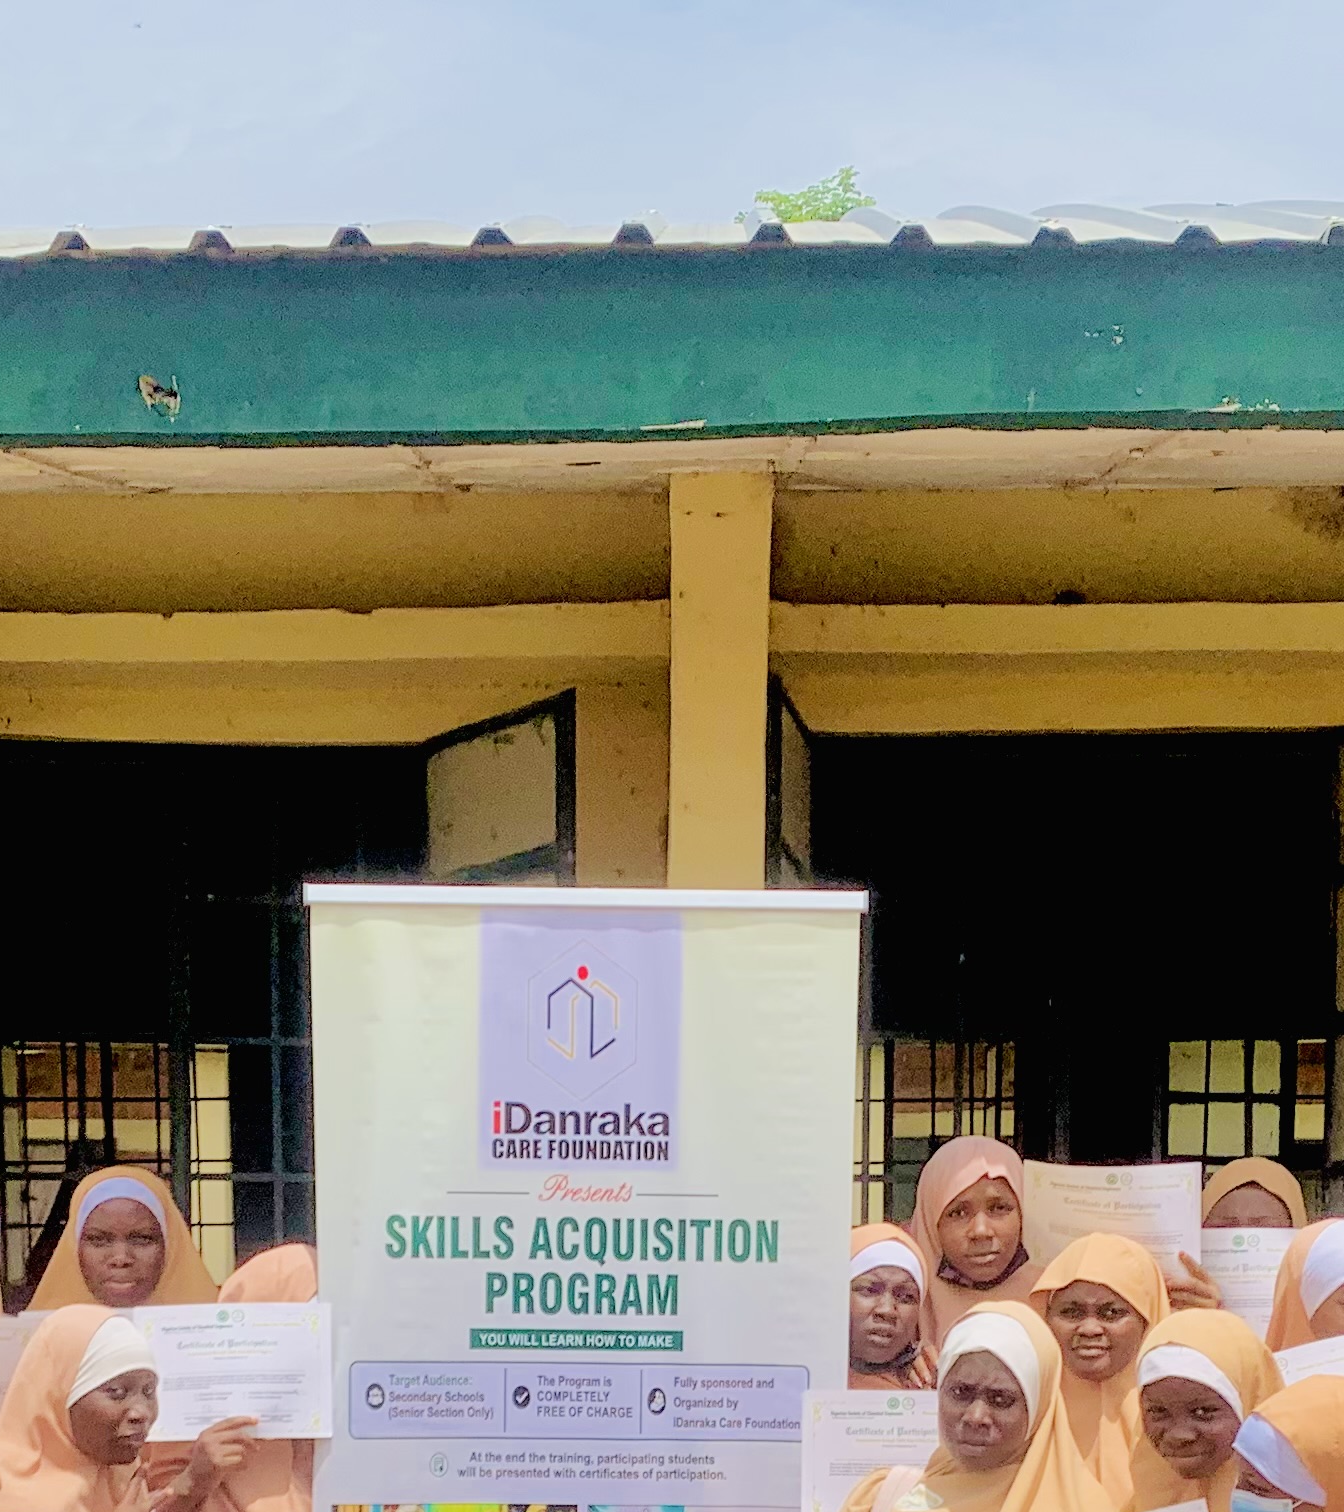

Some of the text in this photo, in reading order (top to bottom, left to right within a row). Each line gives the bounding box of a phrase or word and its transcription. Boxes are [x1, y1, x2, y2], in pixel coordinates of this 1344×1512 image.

[493, 1101, 669, 1136] iDanraka
[492, 1139, 669, 1161] CARE FOUNDATION
[538, 1175, 634, 1204] Presents
[385, 1214, 779, 1265] SKILLS ACQUISITION
[485, 1272, 679, 1316] PROGRAM
[479, 1334, 673, 1347] YOU WILL LEARN HOW TO MAKE
[389, 1374, 472, 1388] Target Audience:
[537, 1376, 612, 1389] The Program is
[674, 1377, 774, 1390] Fully sponsored and
[389, 1392, 484, 1405] Secondary Schools
[537, 1391, 609, 1402] COMPLETELY
[674, 1398, 738, 1410] Organized by
[388, 1407, 494, 1420] (Senior Section Only)
[537, 1406, 633, 1418] FREE OF CHARGE
[719, 1418, 741, 1429] Care
[745, 1418, 801, 1429] Foundation
[470, 1452, 715, 1466] At the end the training, participating students
[457, 1468, 727, 1482] will be presented with certificates of participation.
